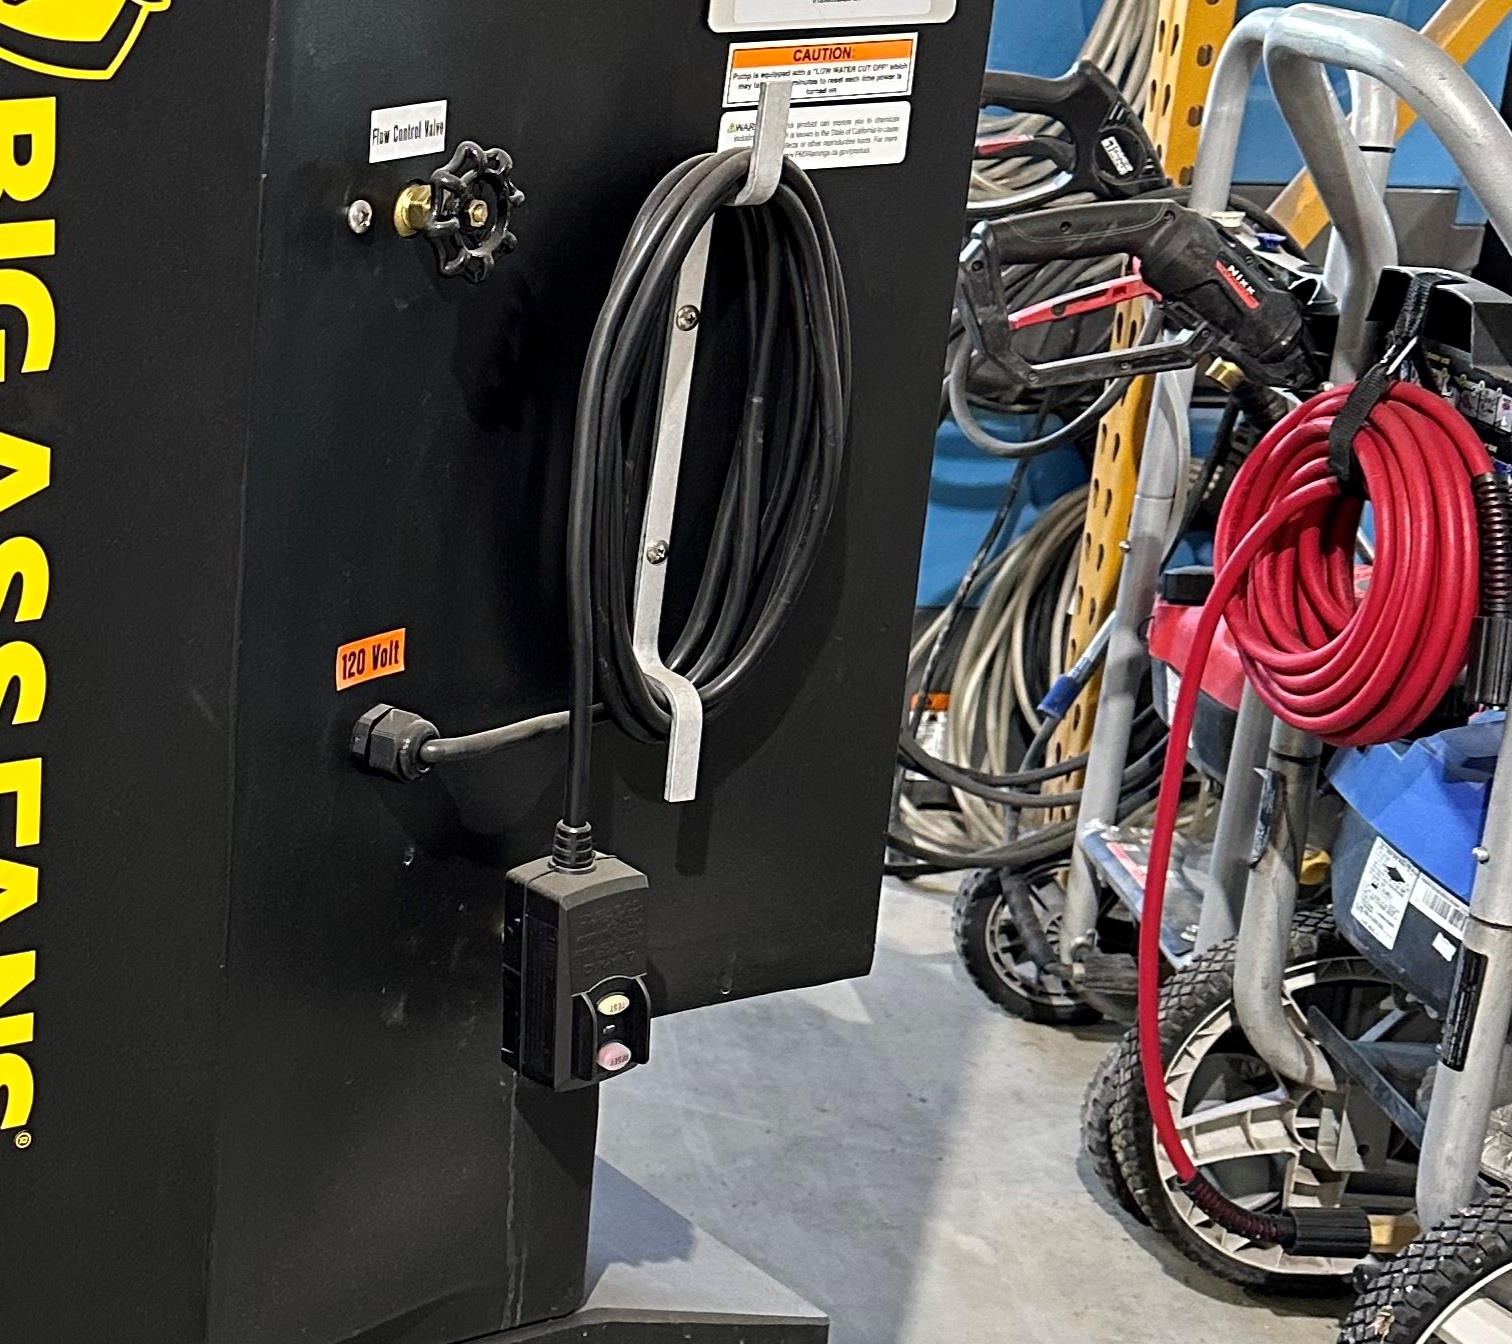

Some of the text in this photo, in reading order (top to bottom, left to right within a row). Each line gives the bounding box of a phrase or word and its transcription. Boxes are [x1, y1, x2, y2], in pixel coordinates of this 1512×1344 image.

[372, 118, 444, 146] Flow Control Valve
[341, 639, 400, 681] 120 Volt
